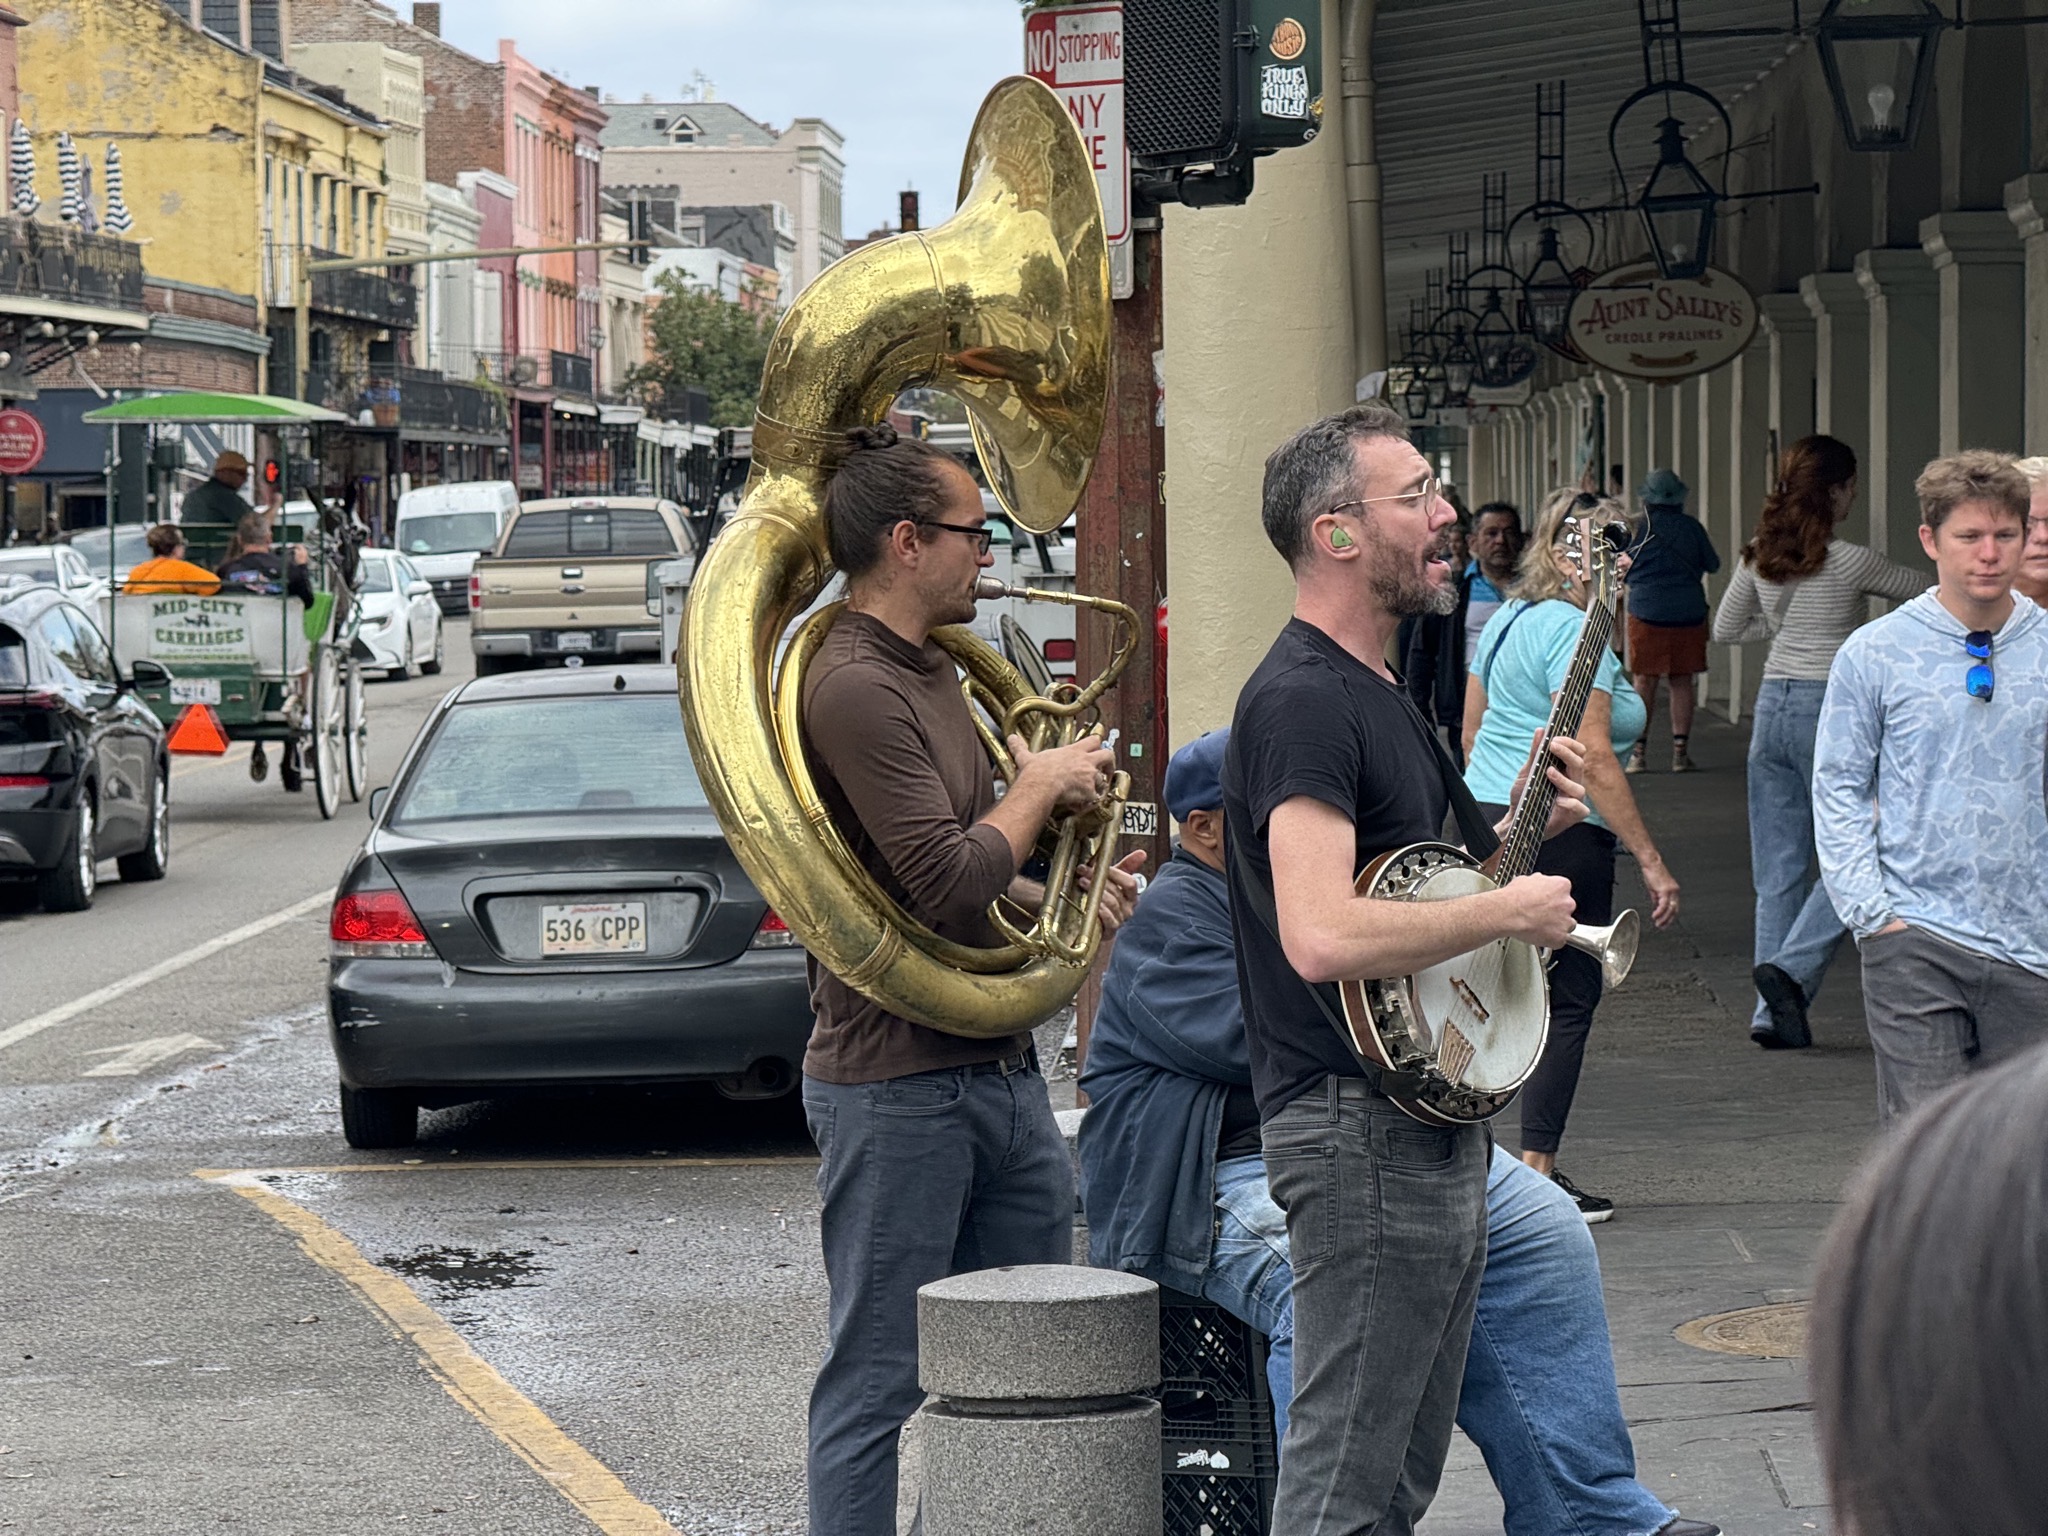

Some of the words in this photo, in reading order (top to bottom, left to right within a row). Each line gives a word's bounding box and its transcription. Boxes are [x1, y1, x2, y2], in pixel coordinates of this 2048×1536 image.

[1028, 29, 1055, 73] NO
[1059, 31, 1121, 64] STOPPING
[1067, 93, 1106, 129] NY
[1261, 99, 1306, 116] ONLY
[1577, 297, 1650, 335] AUNT
[1656, 287, 1743, 328] SALLY'S
[1605, 332, 1653, 344] CREOLE
[1658, 329, 1723, 344] PRALINES
[153, 599, 245, 618] MID-CITY
[155, 628, 245, 646] CARRIAGES
[546, 918, 586, 942] 536
[601, 916, 640, 941] CPP
